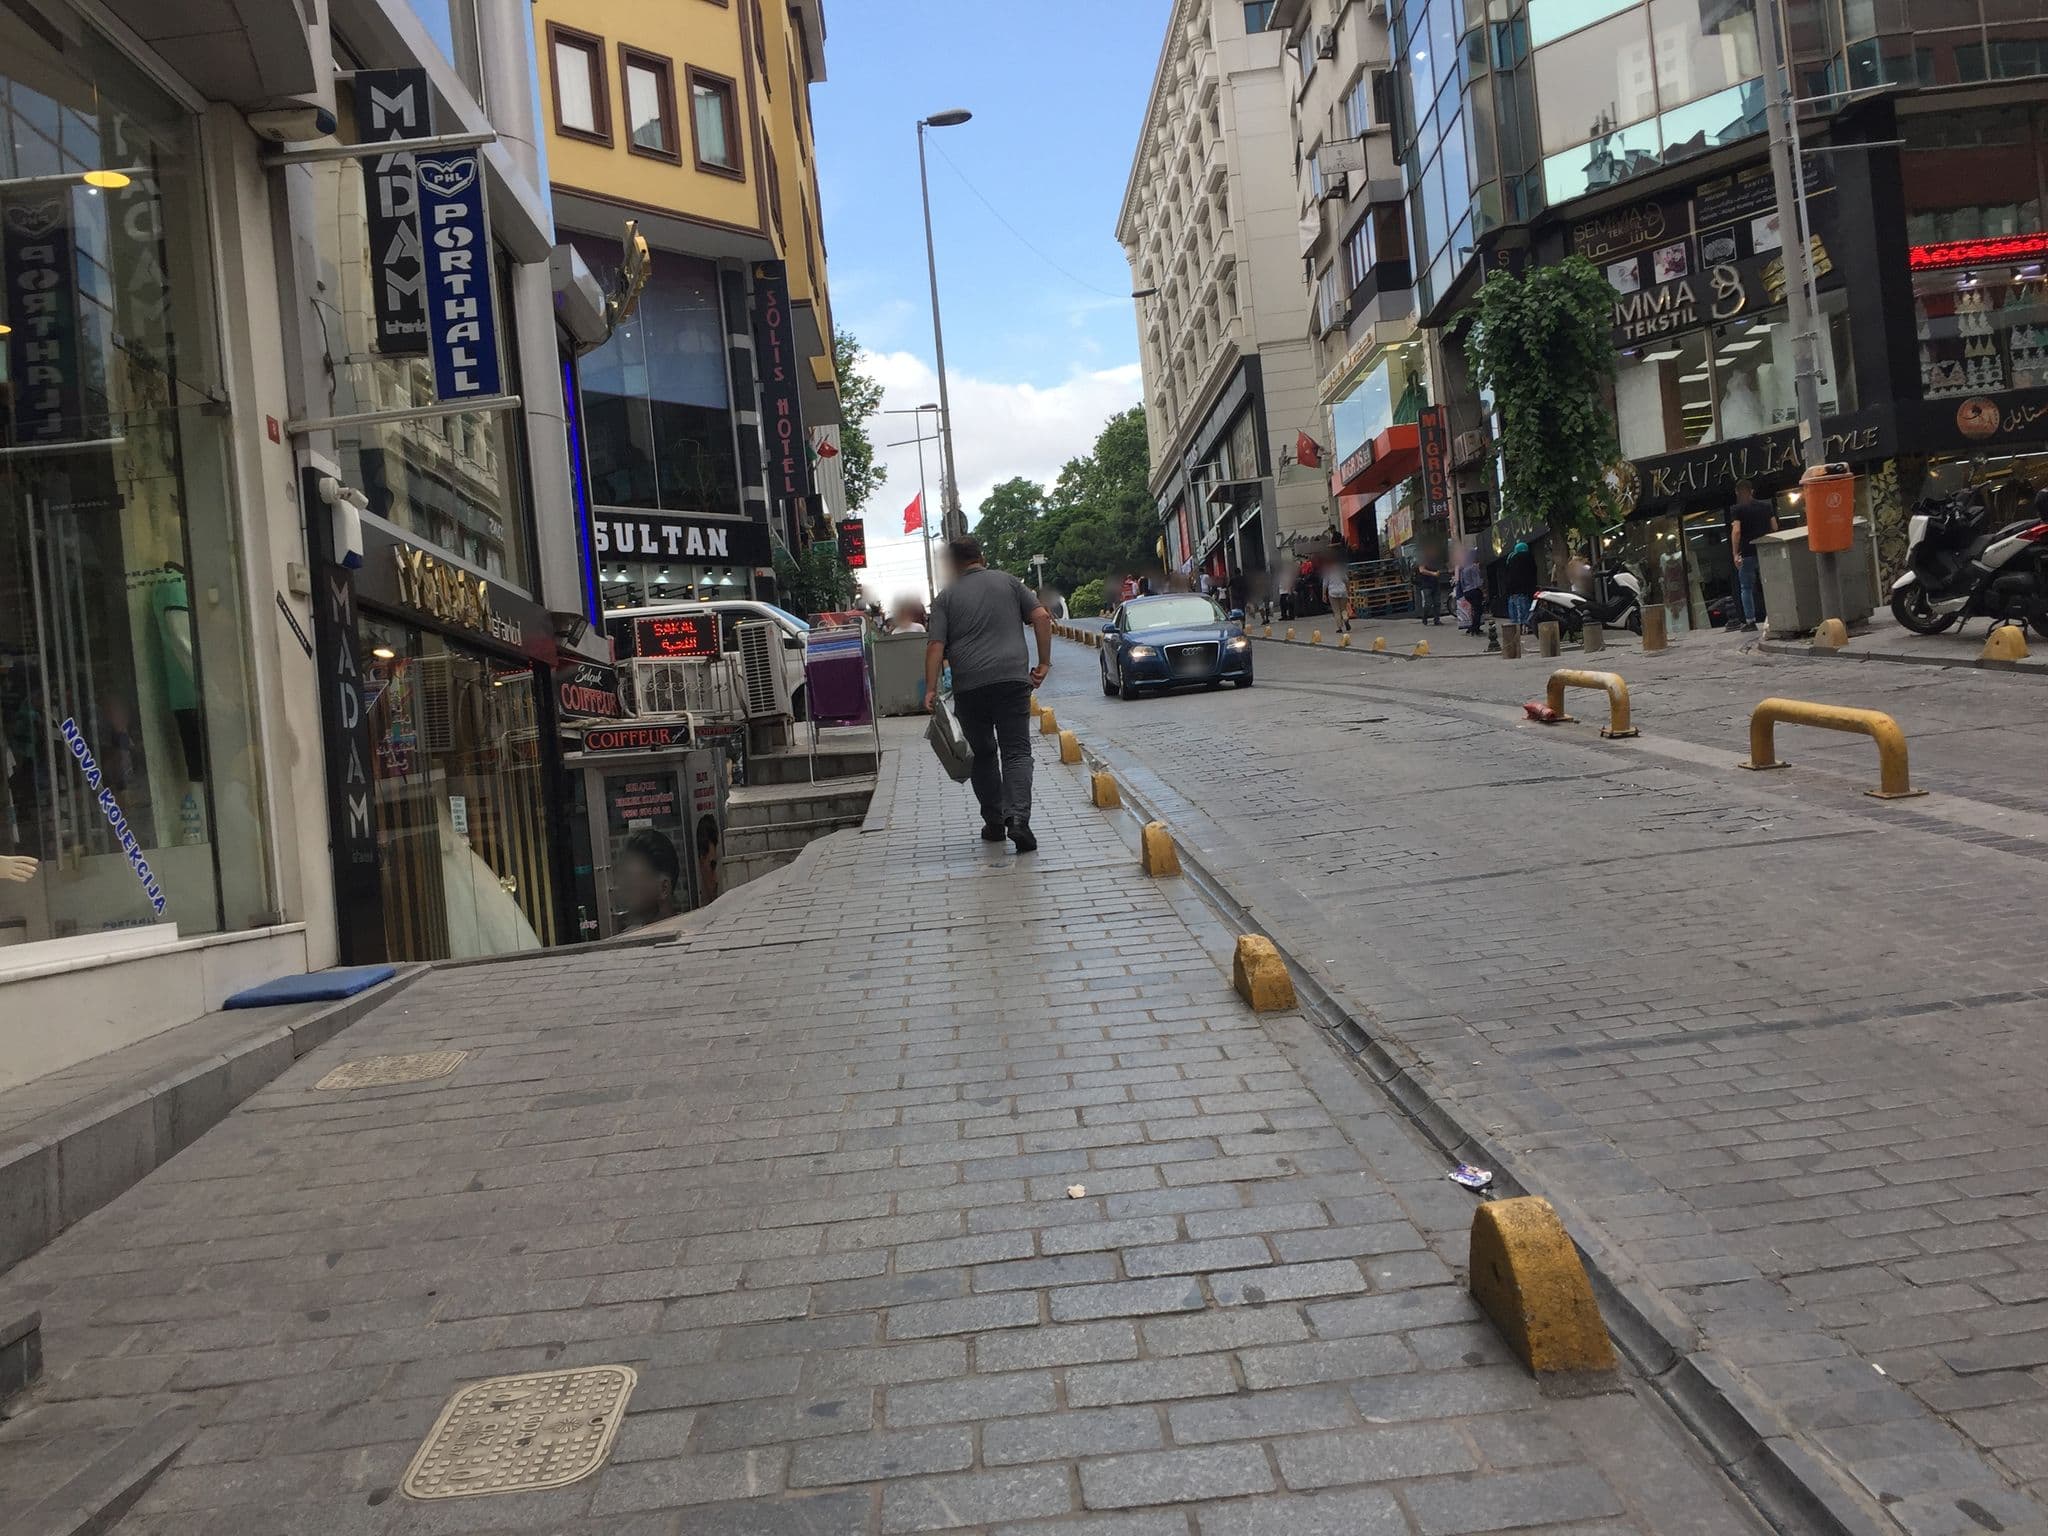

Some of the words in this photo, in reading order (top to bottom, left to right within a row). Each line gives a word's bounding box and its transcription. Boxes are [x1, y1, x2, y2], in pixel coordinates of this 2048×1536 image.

[433, 172, 463, 184] PHL
[1909, 238, 2048, 264] Accesso
[432, 202, 481, 392] PORTHALL
[1605, 280, 1697, 328] MMA
[765, 290, 785, 381] SOLIS
[776, 398, 795, 494] HOTEL
[1421, 413, 1444, 500] MIGROS
[1823, 426, 1881, 457] TYLE
[1430, 501, 1449, 516] jet
[594, 520, 729, 557] SULTAN
[330, 574, 370, 839] MADAM
[561, 683, 619, 716] COIFFEUR
[587, 727, 673, 750] COIFFEUR
[61, 717, 102, 791] NOVA
[97, 787, 168, 916] KOLEKCIJA
